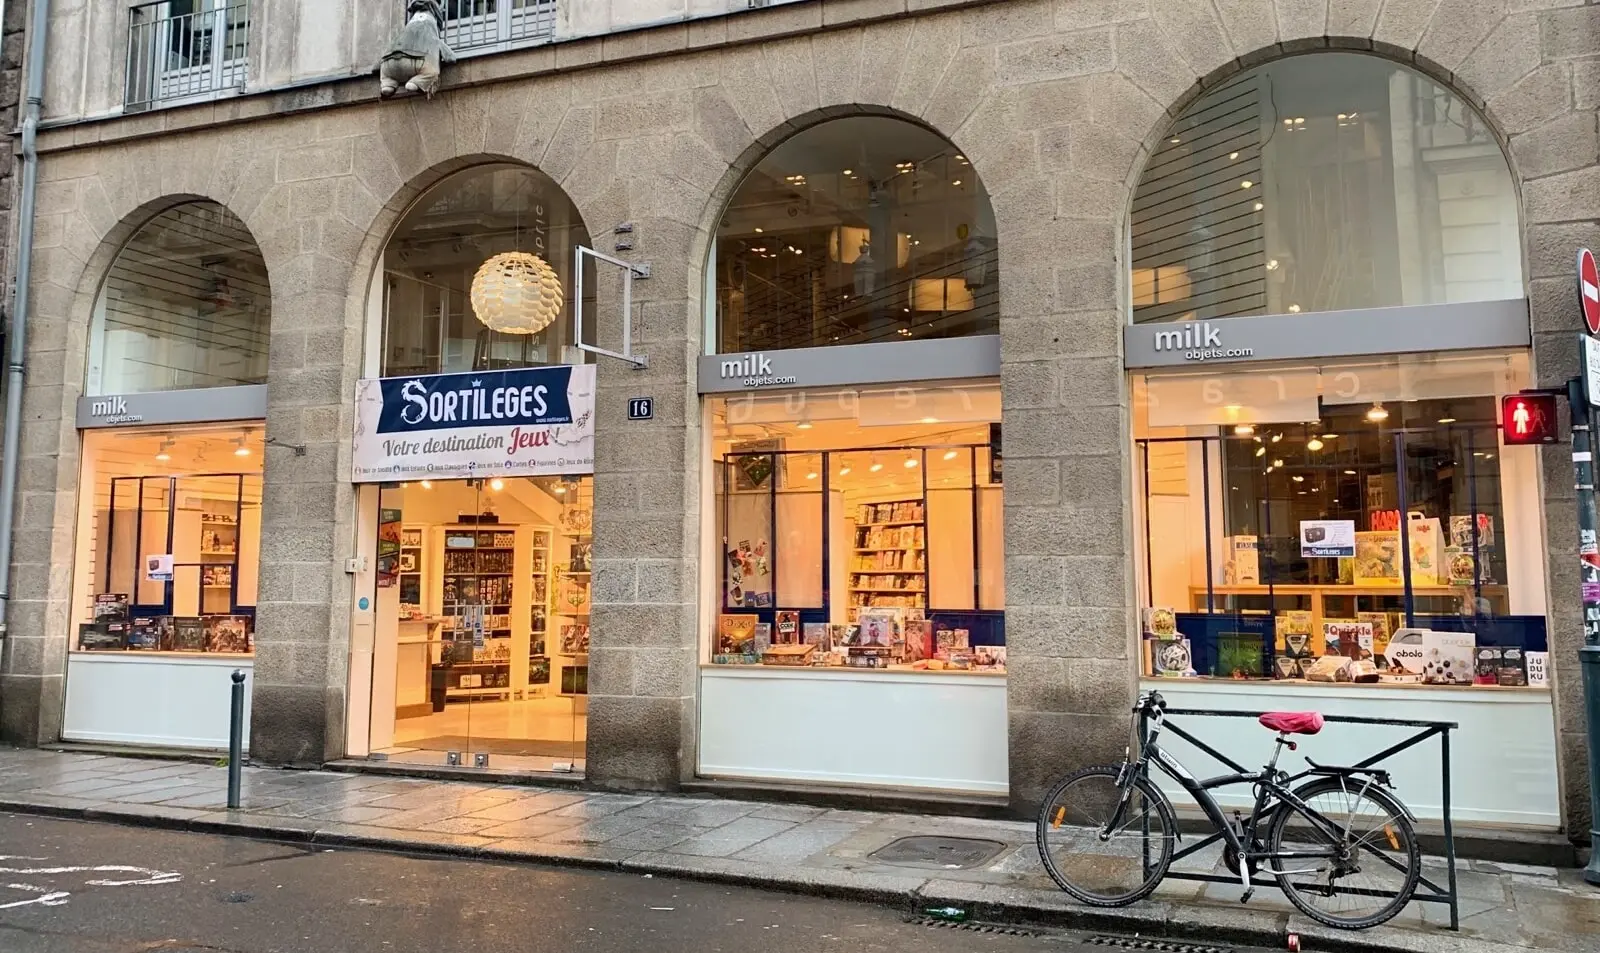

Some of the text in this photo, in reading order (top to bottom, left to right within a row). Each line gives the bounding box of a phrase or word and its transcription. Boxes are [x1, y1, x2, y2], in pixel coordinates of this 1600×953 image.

[1155, 322, 1222, 350] milk
[1185, 347, 1253, 361] objets.com
[721, 353, 773, 378] milk
[743, 375, 797, 387] objets.com
[92, 396, 127, 416] milk
[400, 378, 548, 425] SORTILEGES
[632, 401, 648, 416] 16
[106, 415, 143, 424] objets.com
[382, 438, 420, 457] Votre
[423, 433, 504, 454] destination
[507, 427, 550, 455] Jeux
